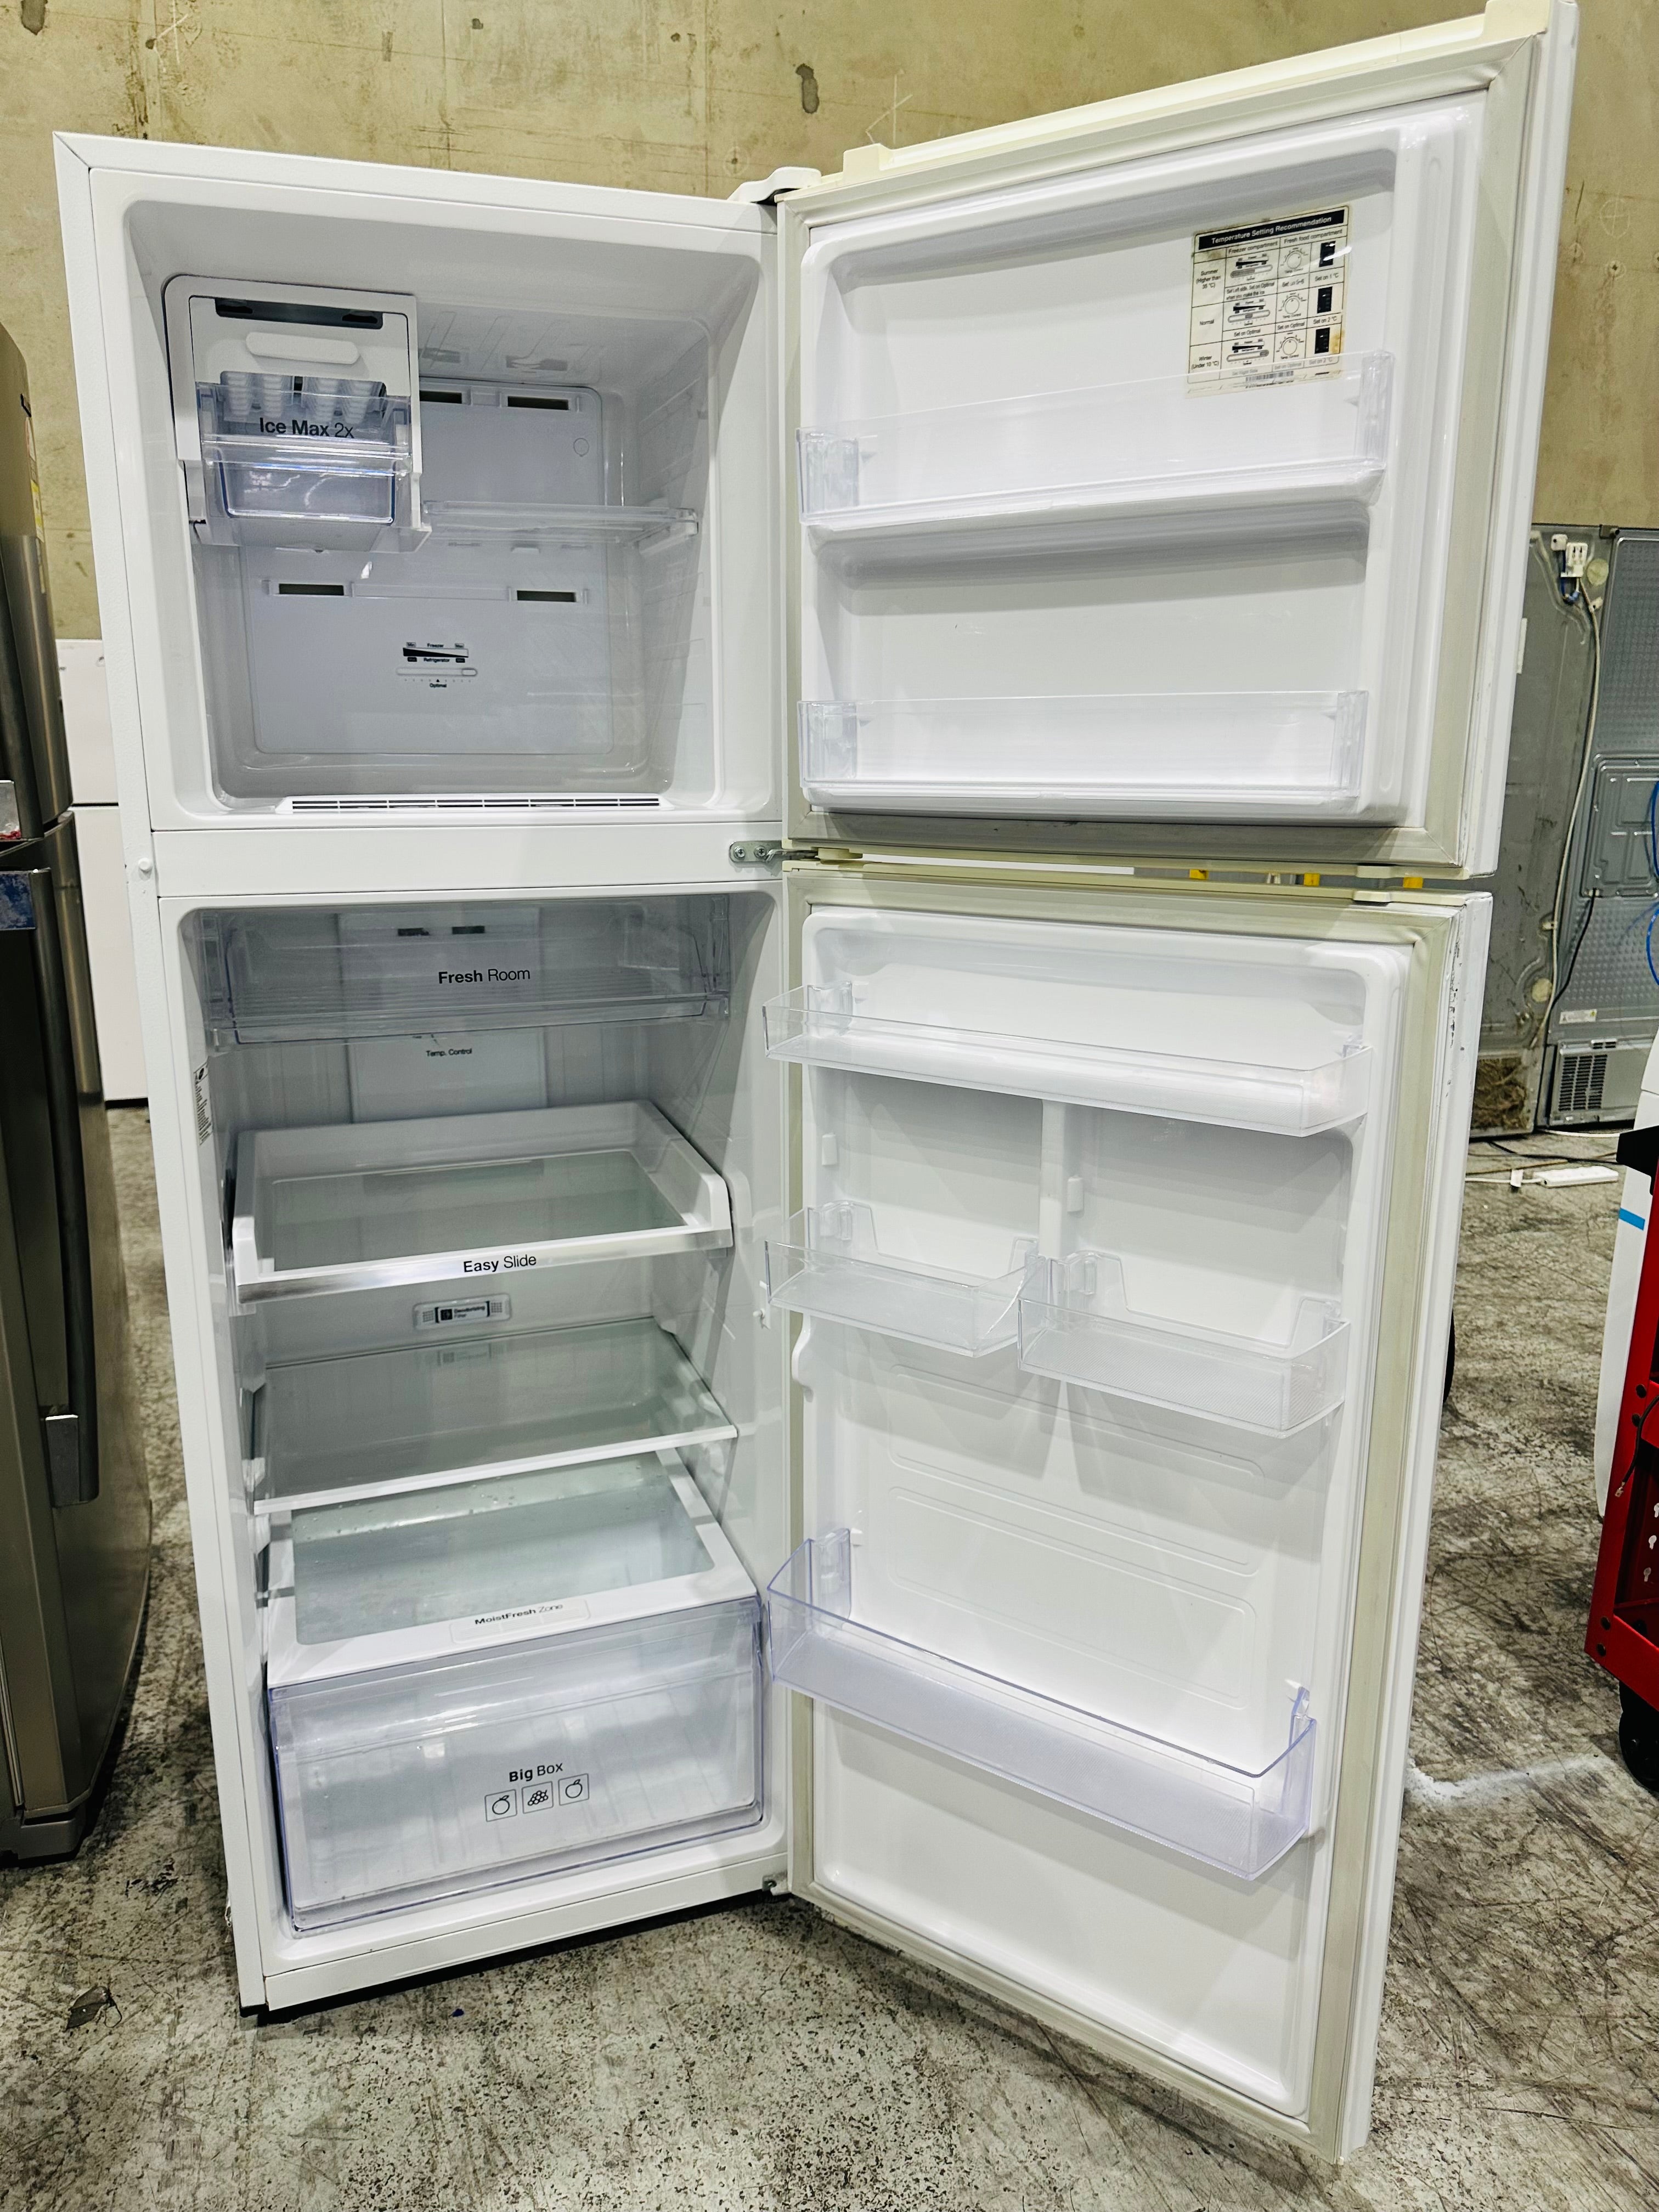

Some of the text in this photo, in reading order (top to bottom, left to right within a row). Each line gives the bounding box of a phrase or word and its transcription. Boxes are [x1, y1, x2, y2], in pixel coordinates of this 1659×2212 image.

[1211, 216, 1332, 244] Temperature Setting Recommendation
[259, 417, 354, 438] Ice Max 2x
[439, 969, 531, 984] Fresh Room
[464, 1254, 537, 1272] Easy Slide
[475, 1604, 563, 1624] MoistFresh Zone
[509, 1763, 563, 1782] Big Box
